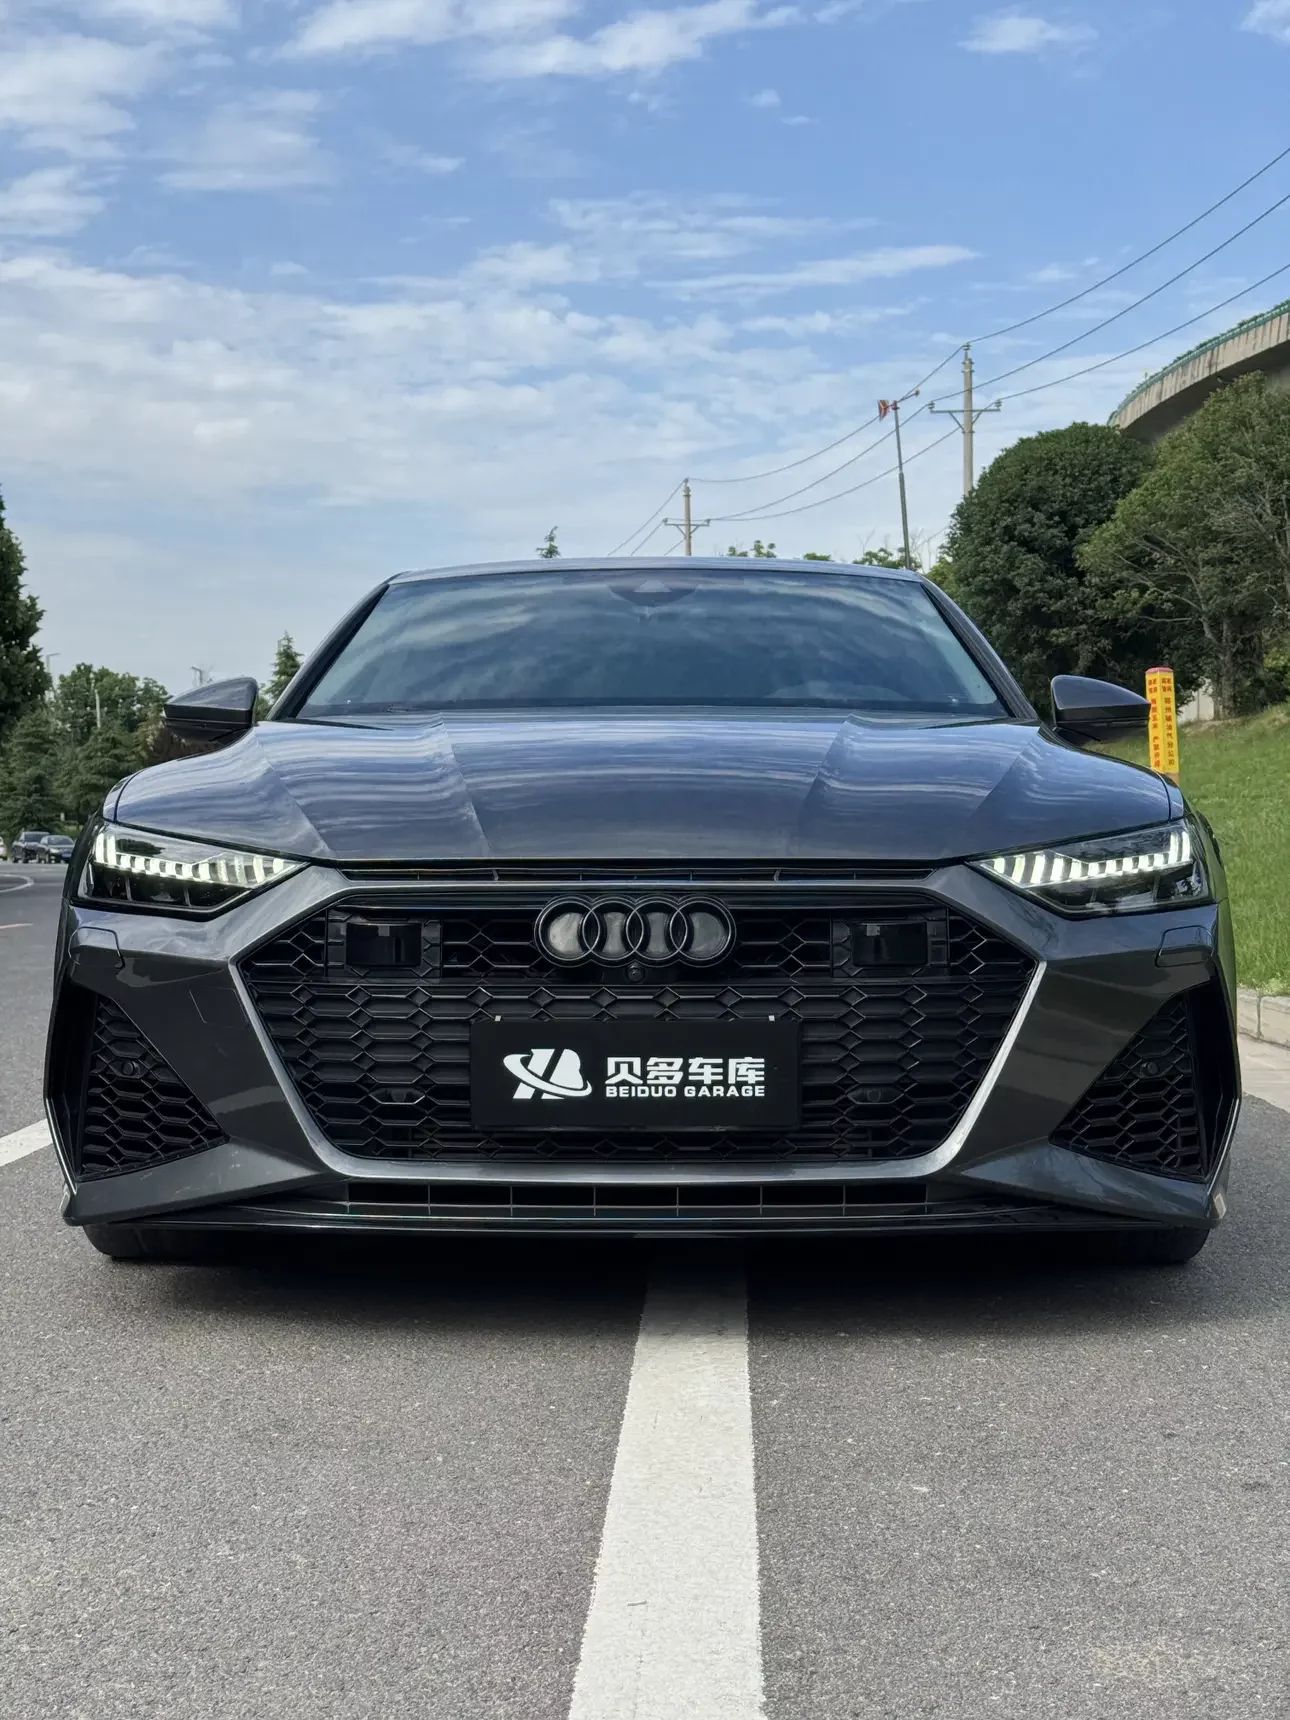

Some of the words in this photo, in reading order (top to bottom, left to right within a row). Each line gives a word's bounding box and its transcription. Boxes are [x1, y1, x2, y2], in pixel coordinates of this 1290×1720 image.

[604, 1056, 765, 1084] 贝多车库
[605, 1086, 677, 1098] BEIDUO
[683, 1086, 765, 1098] GARAGE
